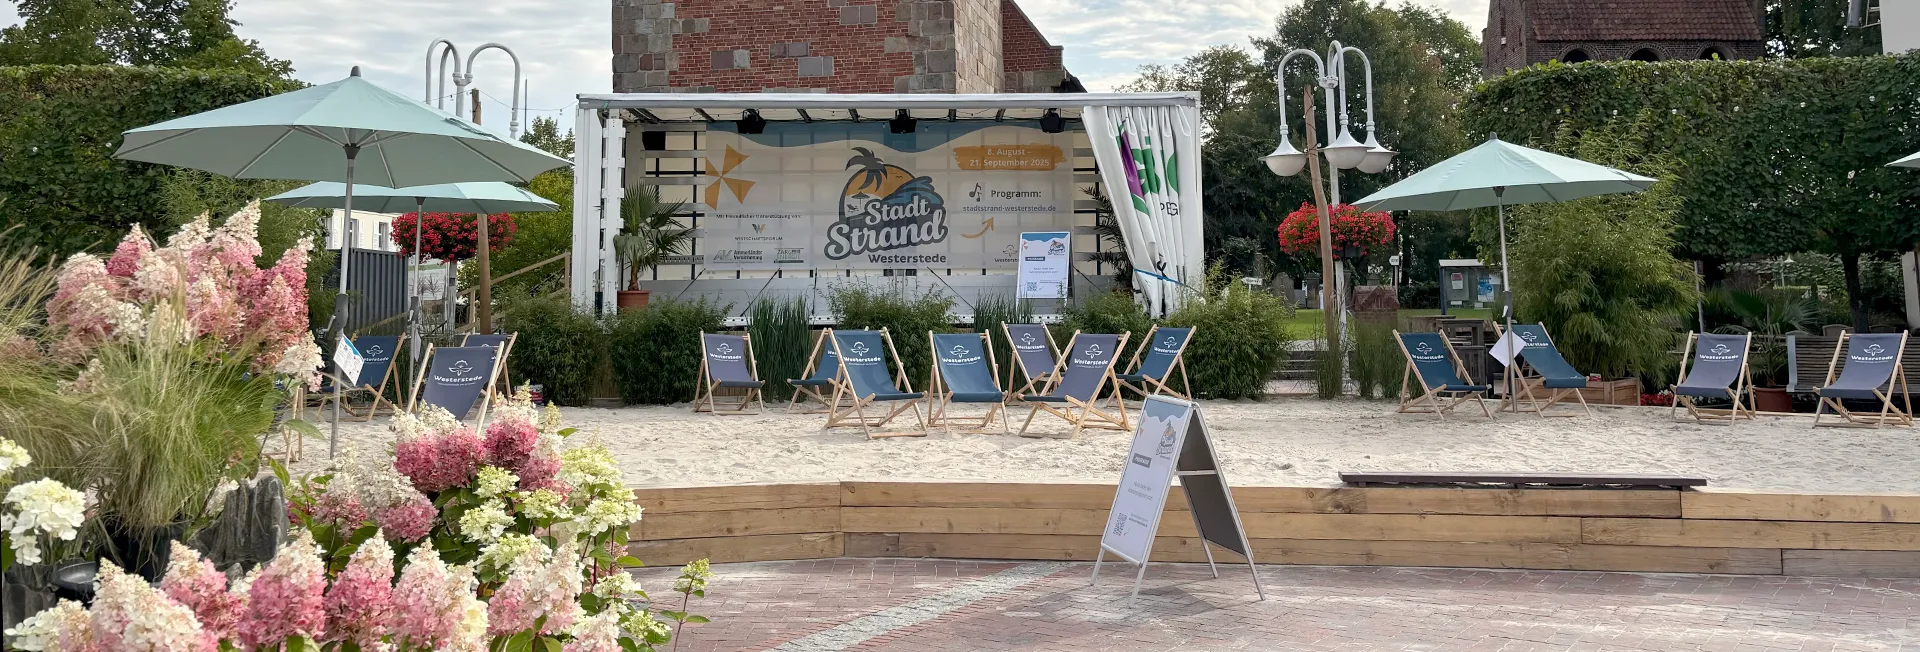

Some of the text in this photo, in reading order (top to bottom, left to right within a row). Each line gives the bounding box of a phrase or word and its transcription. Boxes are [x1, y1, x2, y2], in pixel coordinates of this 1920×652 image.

[987, 148, 995, 156] 8.
[996, 148, 1026, 157] August
[969, 159, 1050, 168] 21. September 2025
[990, 189, 1042, 199] Programm:
[865, 195, 931, 226] Stadt
[827, 209, 945, 257] Strand
[867, 253, 947, 264] Westerstede
[942, 355, 981, 363] Westerstede
[1074, 357, 1109, 365] Westerstede
[433, 374, 483, 383] Westerstede
